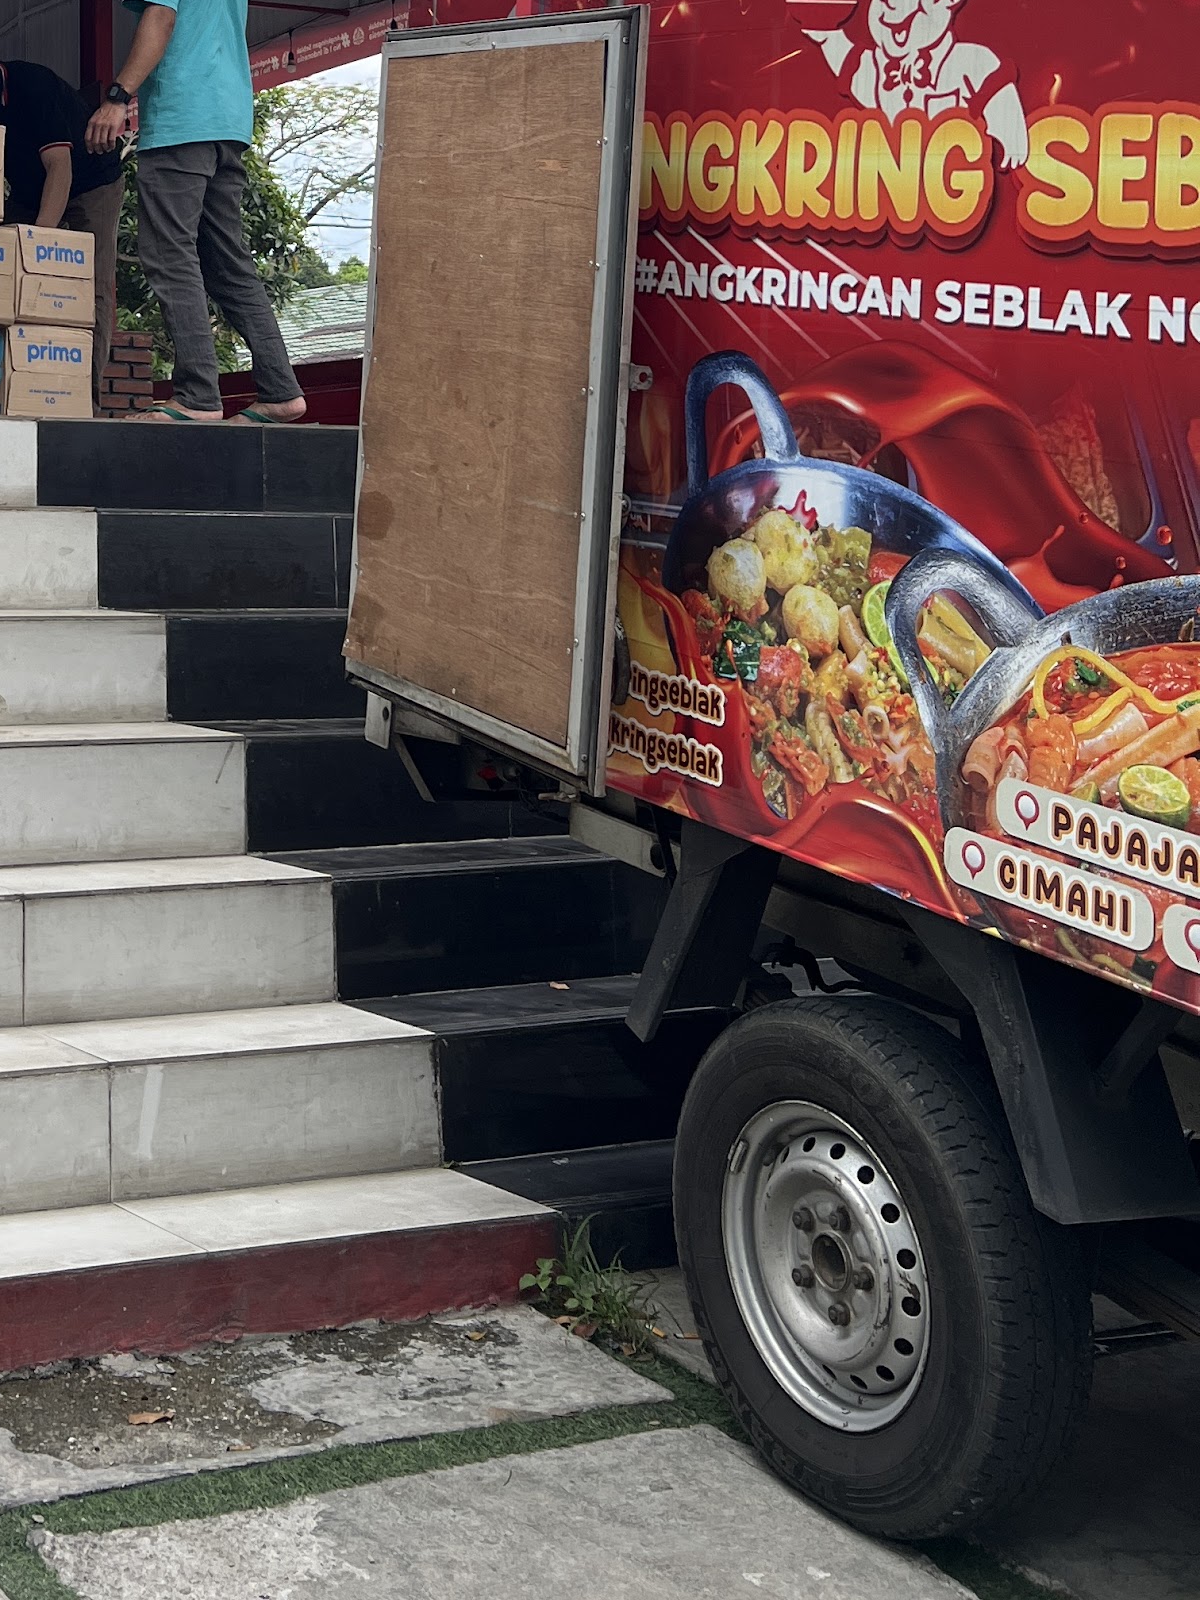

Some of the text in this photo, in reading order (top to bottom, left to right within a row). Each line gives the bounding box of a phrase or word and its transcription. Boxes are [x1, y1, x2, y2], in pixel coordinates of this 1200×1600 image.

[36, 241, 85, 265] prima
[635, 258, 921, 320] #ANGKRINGAN
[935, 280, 1131, 339] SEBLAK
[27, 339, 82, 363] prima
[608, 716, 719, 778] kringseblak
[999, 856, 1132, 934] CIMAHI
